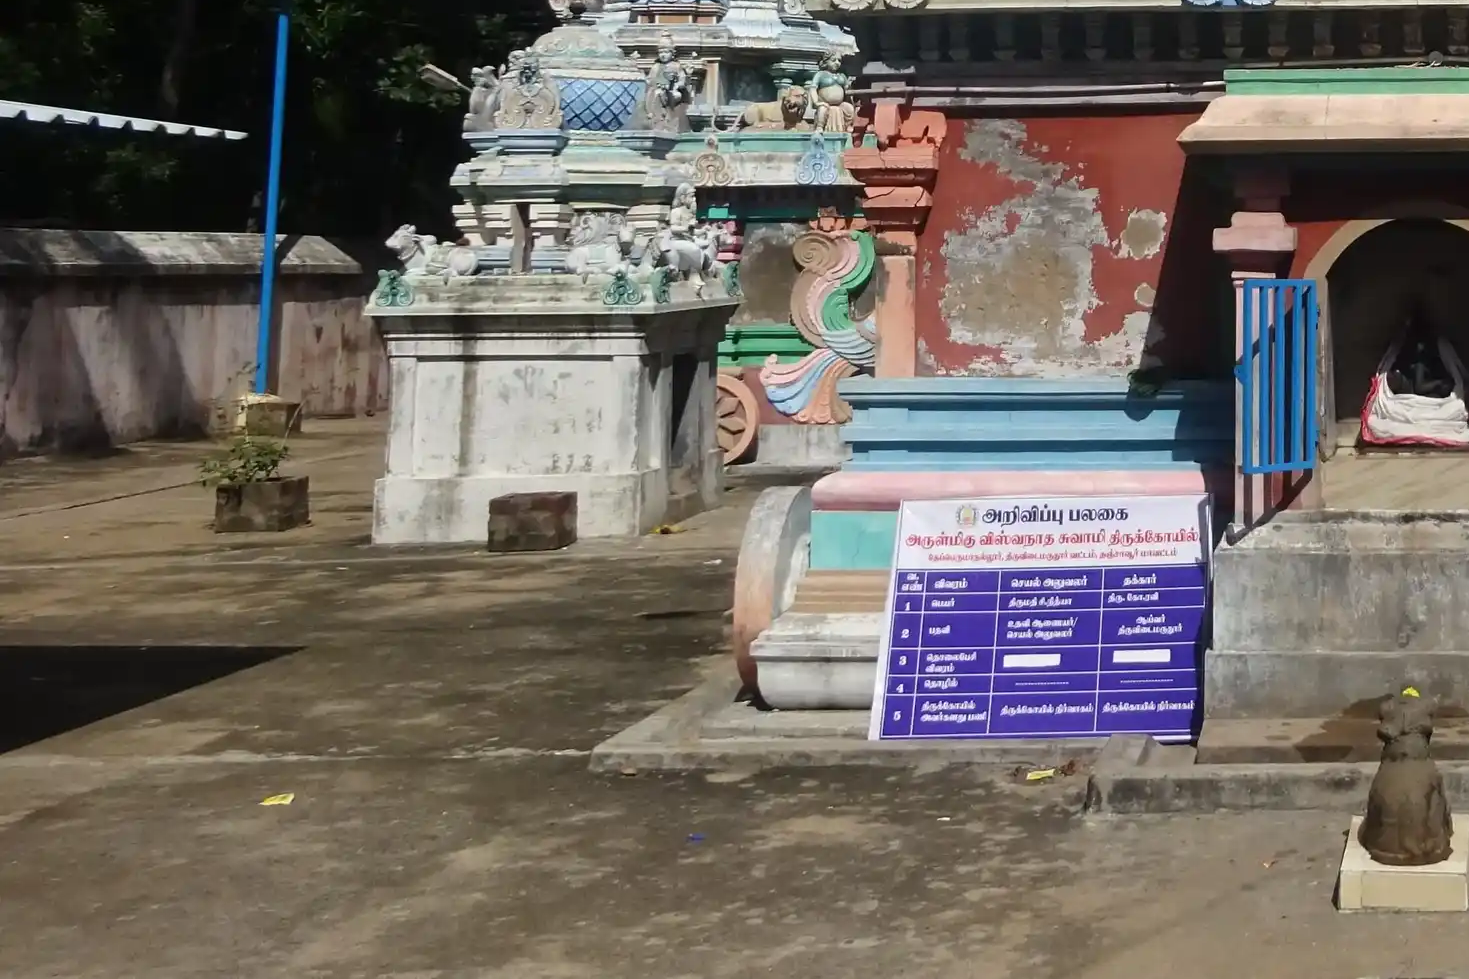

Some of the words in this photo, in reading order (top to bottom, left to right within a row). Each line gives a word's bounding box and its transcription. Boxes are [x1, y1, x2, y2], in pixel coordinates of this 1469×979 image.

[982, 503, 1063, 527] அறிவிப்பு
[1068, 506, 1129, 522] பலகை
[905, 531, 976, 549] அருள்மிகு
[979, 530, 1055, 549] விஸ்வநாத
[1058, 528, 1106, 544] சுவாமி
[1108, 527, 1199, 547] திருக்கோயில்
[934, 577, 968, 590] விவரம்
[1010, 576, 1041, 589] செயல்
[1043, 574, 1088, 590] அலுவலர்
[1122, 573, 1158, 587] தக்கார்
[904, 600, 911, 611] 1
[931, 597, 956, 608] பெயர்
[1008, 596, 1038, 609] திருமதி
[929, 624, 950, 636] பதவி
[1007, 618, 1031, 629] உதவி
[901, 628, 909, 639] 2
[1006, 628, 1033, 640] செயல்
[1034, 626, 1073, 641] அலுவலர்
[899, 655, 907, 666] 3
[896, 683, 904, 694] 4
[1000, 703, 1054, 717] திருக்கோயில்
[1102, 701, 1156, 714] திருக்கோயில்
[893, 710, 901, 721] 5
